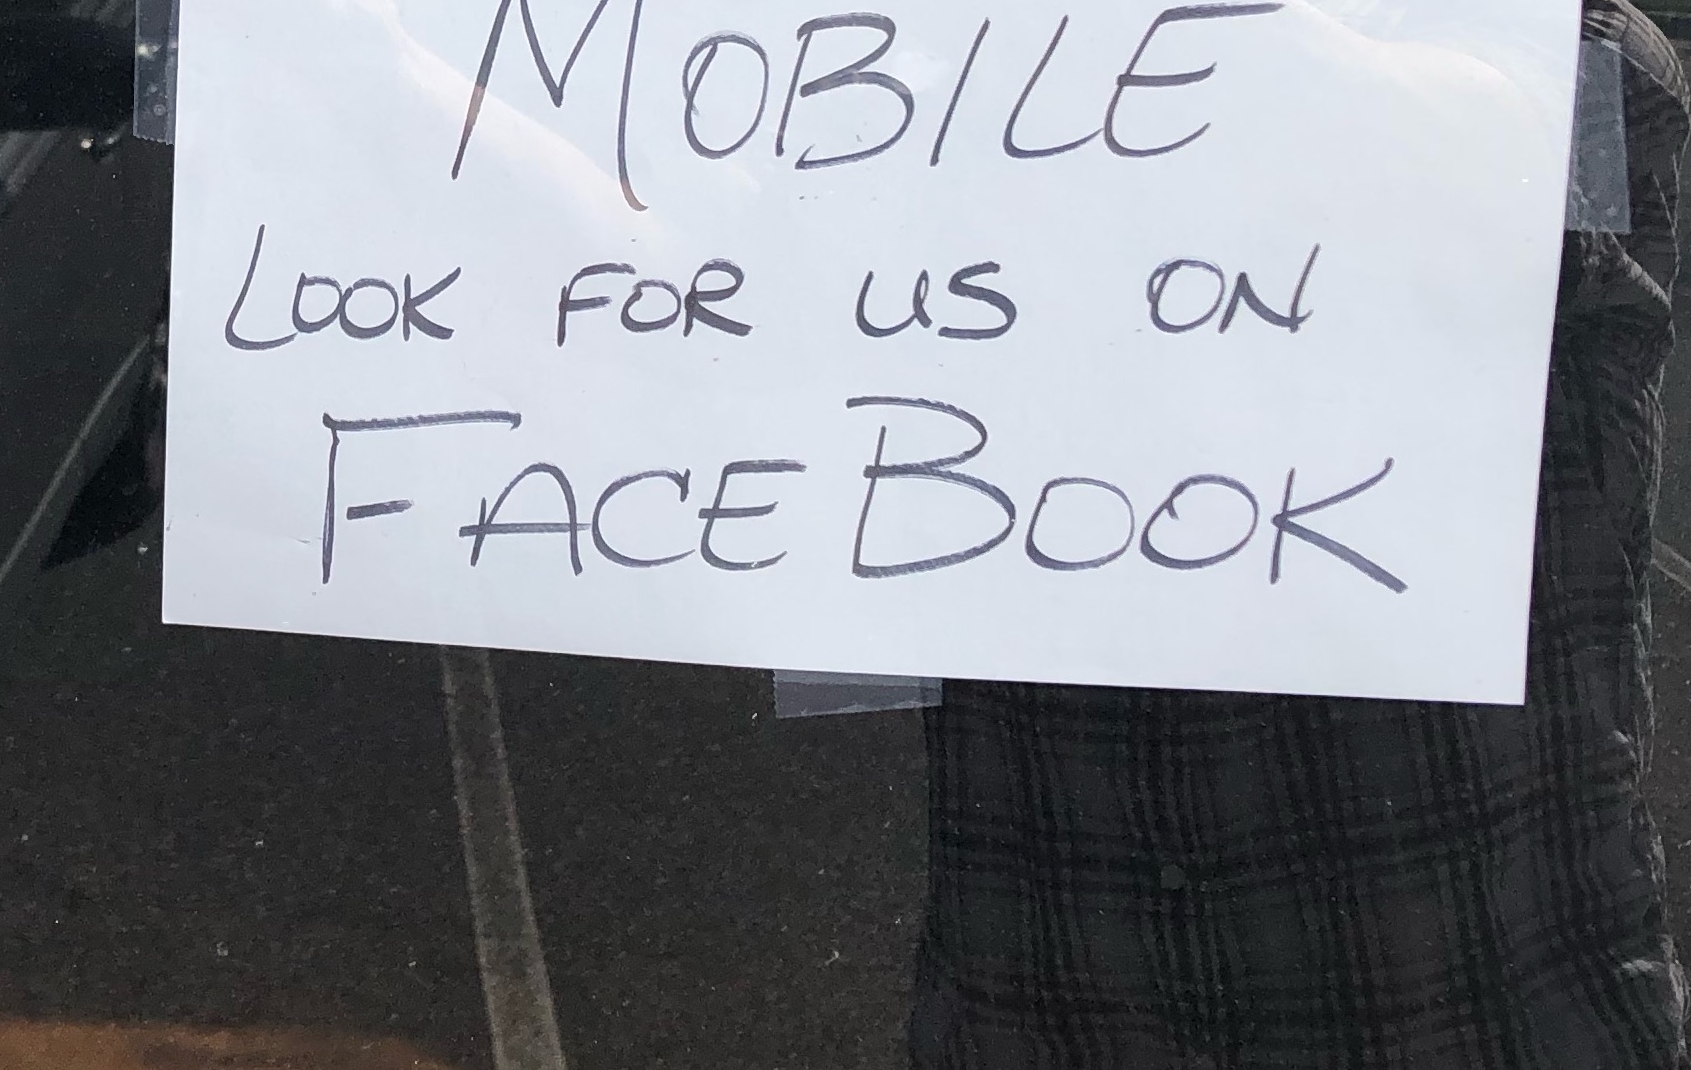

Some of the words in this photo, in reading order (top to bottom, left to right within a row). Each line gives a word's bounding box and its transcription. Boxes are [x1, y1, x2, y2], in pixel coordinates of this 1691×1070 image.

[225, 224, 461, 350] LOOK
[557, 258, 753, 347] FOR
[855, 261, 1017, 340] US
[1146, 244, 1320, 334] ON
